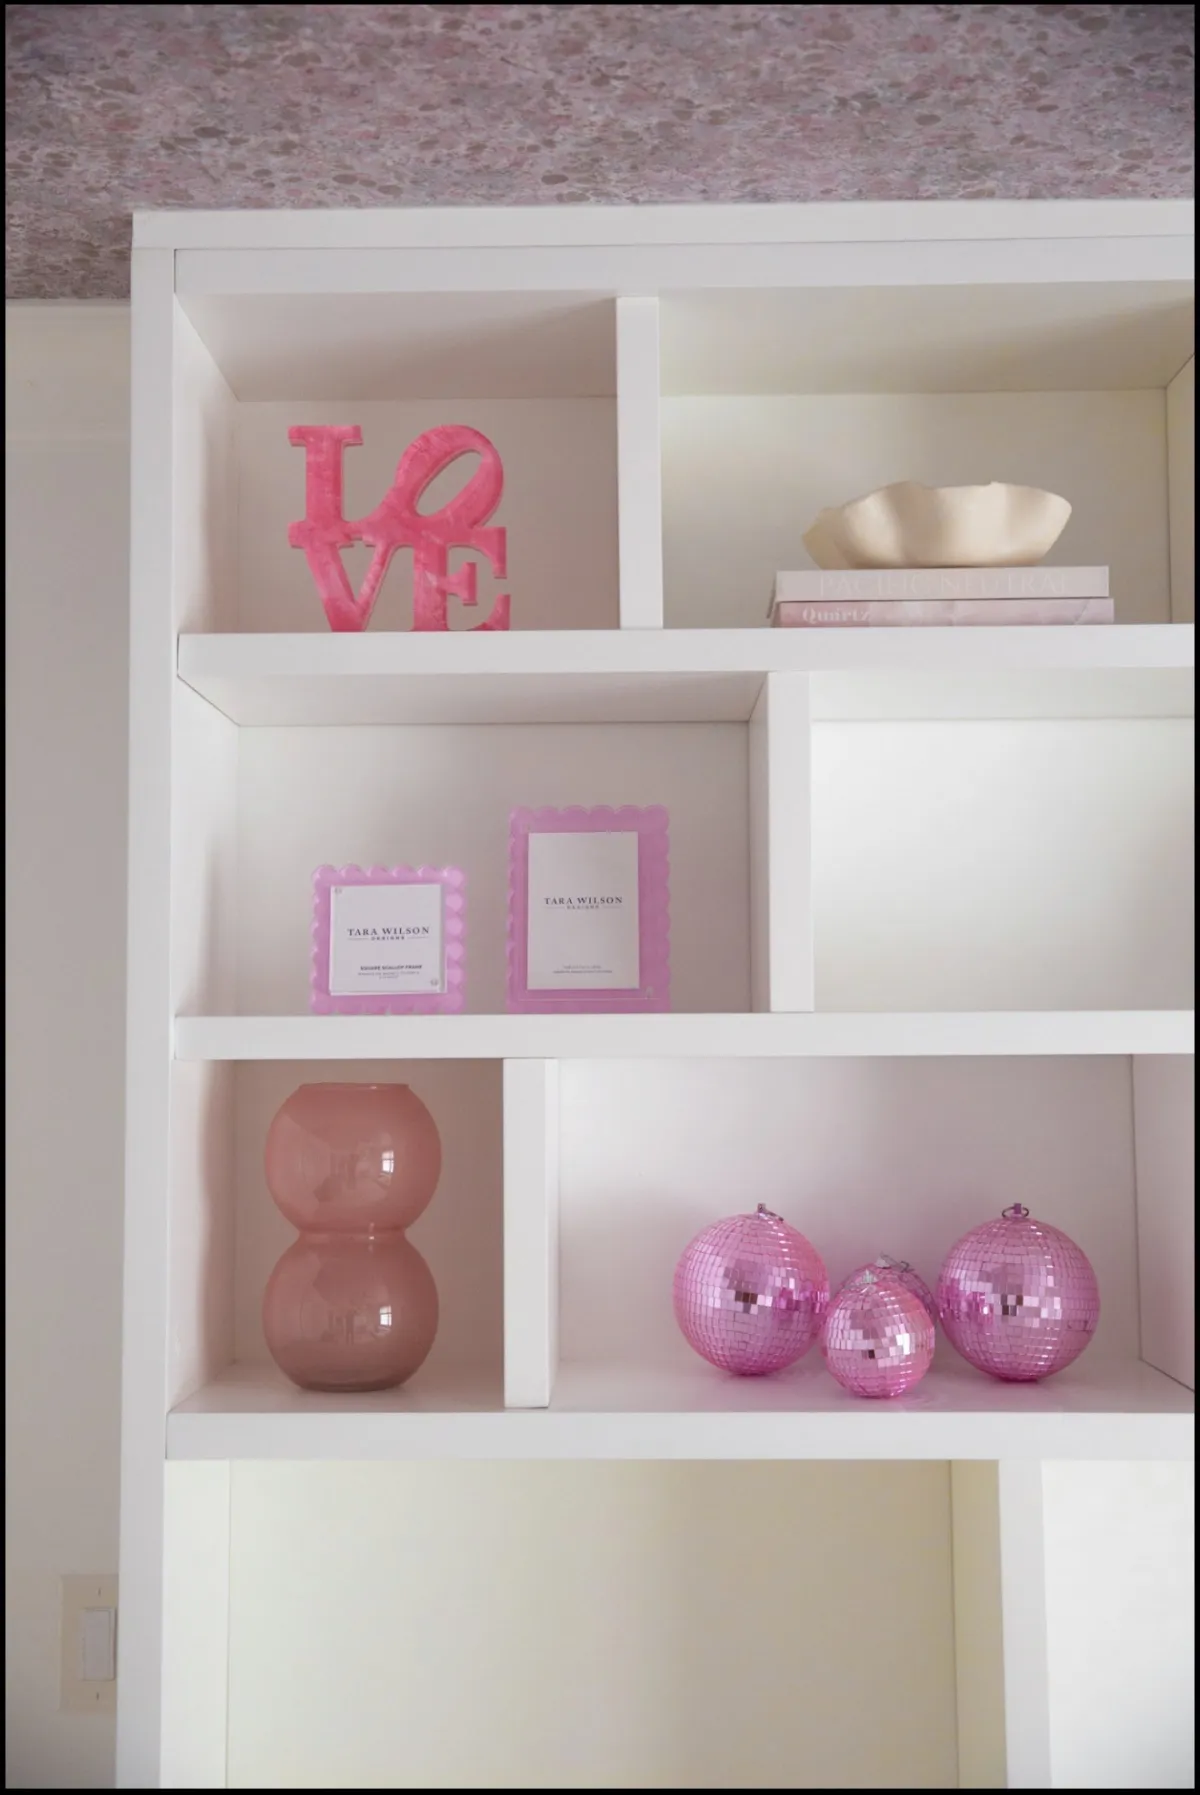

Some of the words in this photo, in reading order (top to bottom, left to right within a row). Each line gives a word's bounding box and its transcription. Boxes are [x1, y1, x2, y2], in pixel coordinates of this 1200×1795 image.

[820, 573, 930, 597] PACIFIC
[940, 572, 1072, 595] NEUTRAL
[802, 607, 870, 625] Quartz
[544, 897, 573, 905] TARA
[577, 896, 623, 904] WILSON
[347, 928, 378, 936] TARA
[382, 926, 430, 935] WILSON
